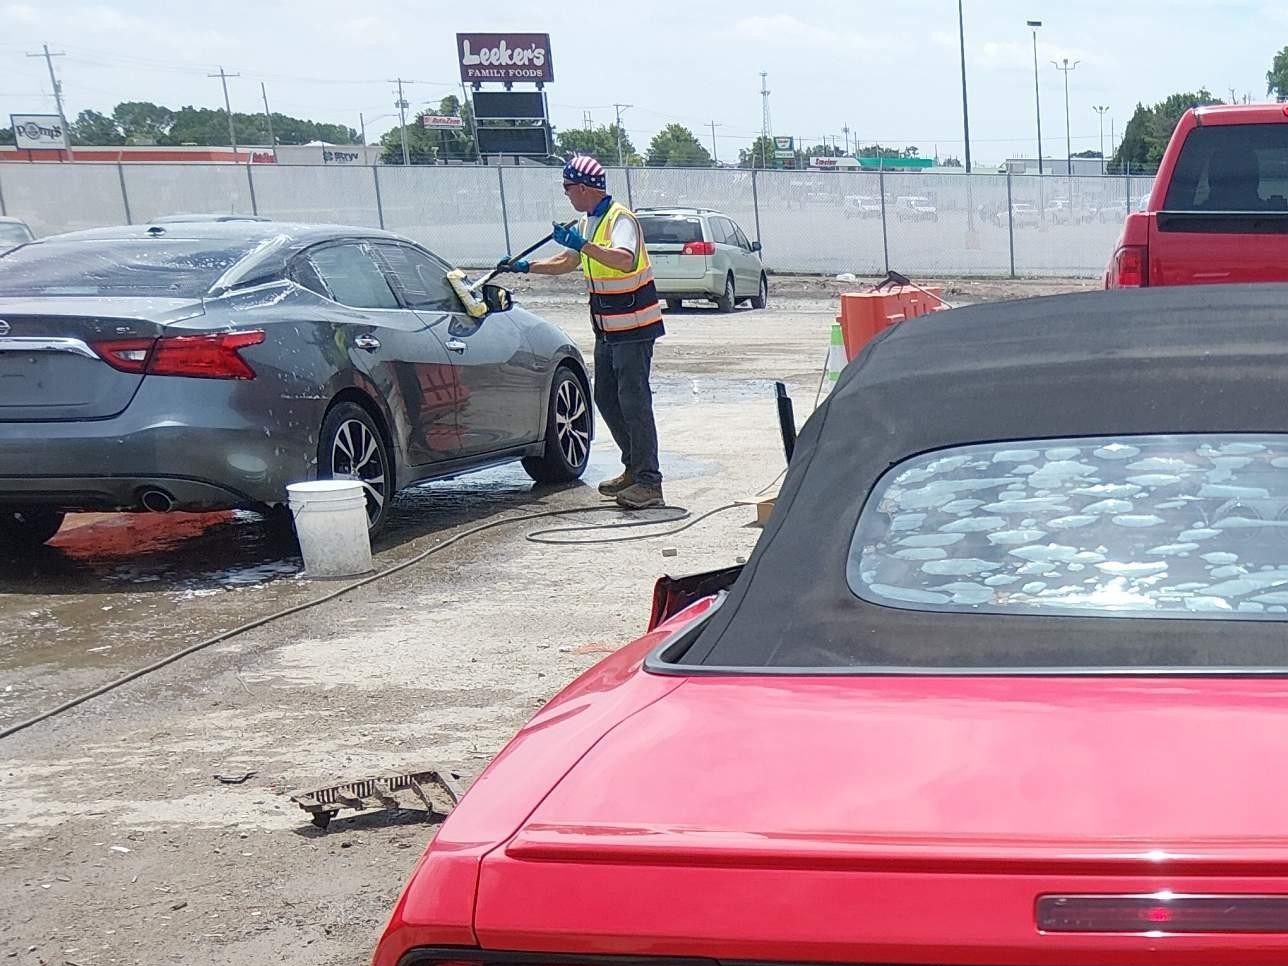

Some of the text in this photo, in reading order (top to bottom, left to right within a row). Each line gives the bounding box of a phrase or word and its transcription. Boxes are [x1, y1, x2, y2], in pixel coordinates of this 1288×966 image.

[463, 40, 545, 66] Leeker's
[468, 69, 543, 77] FAMILY FOODS
